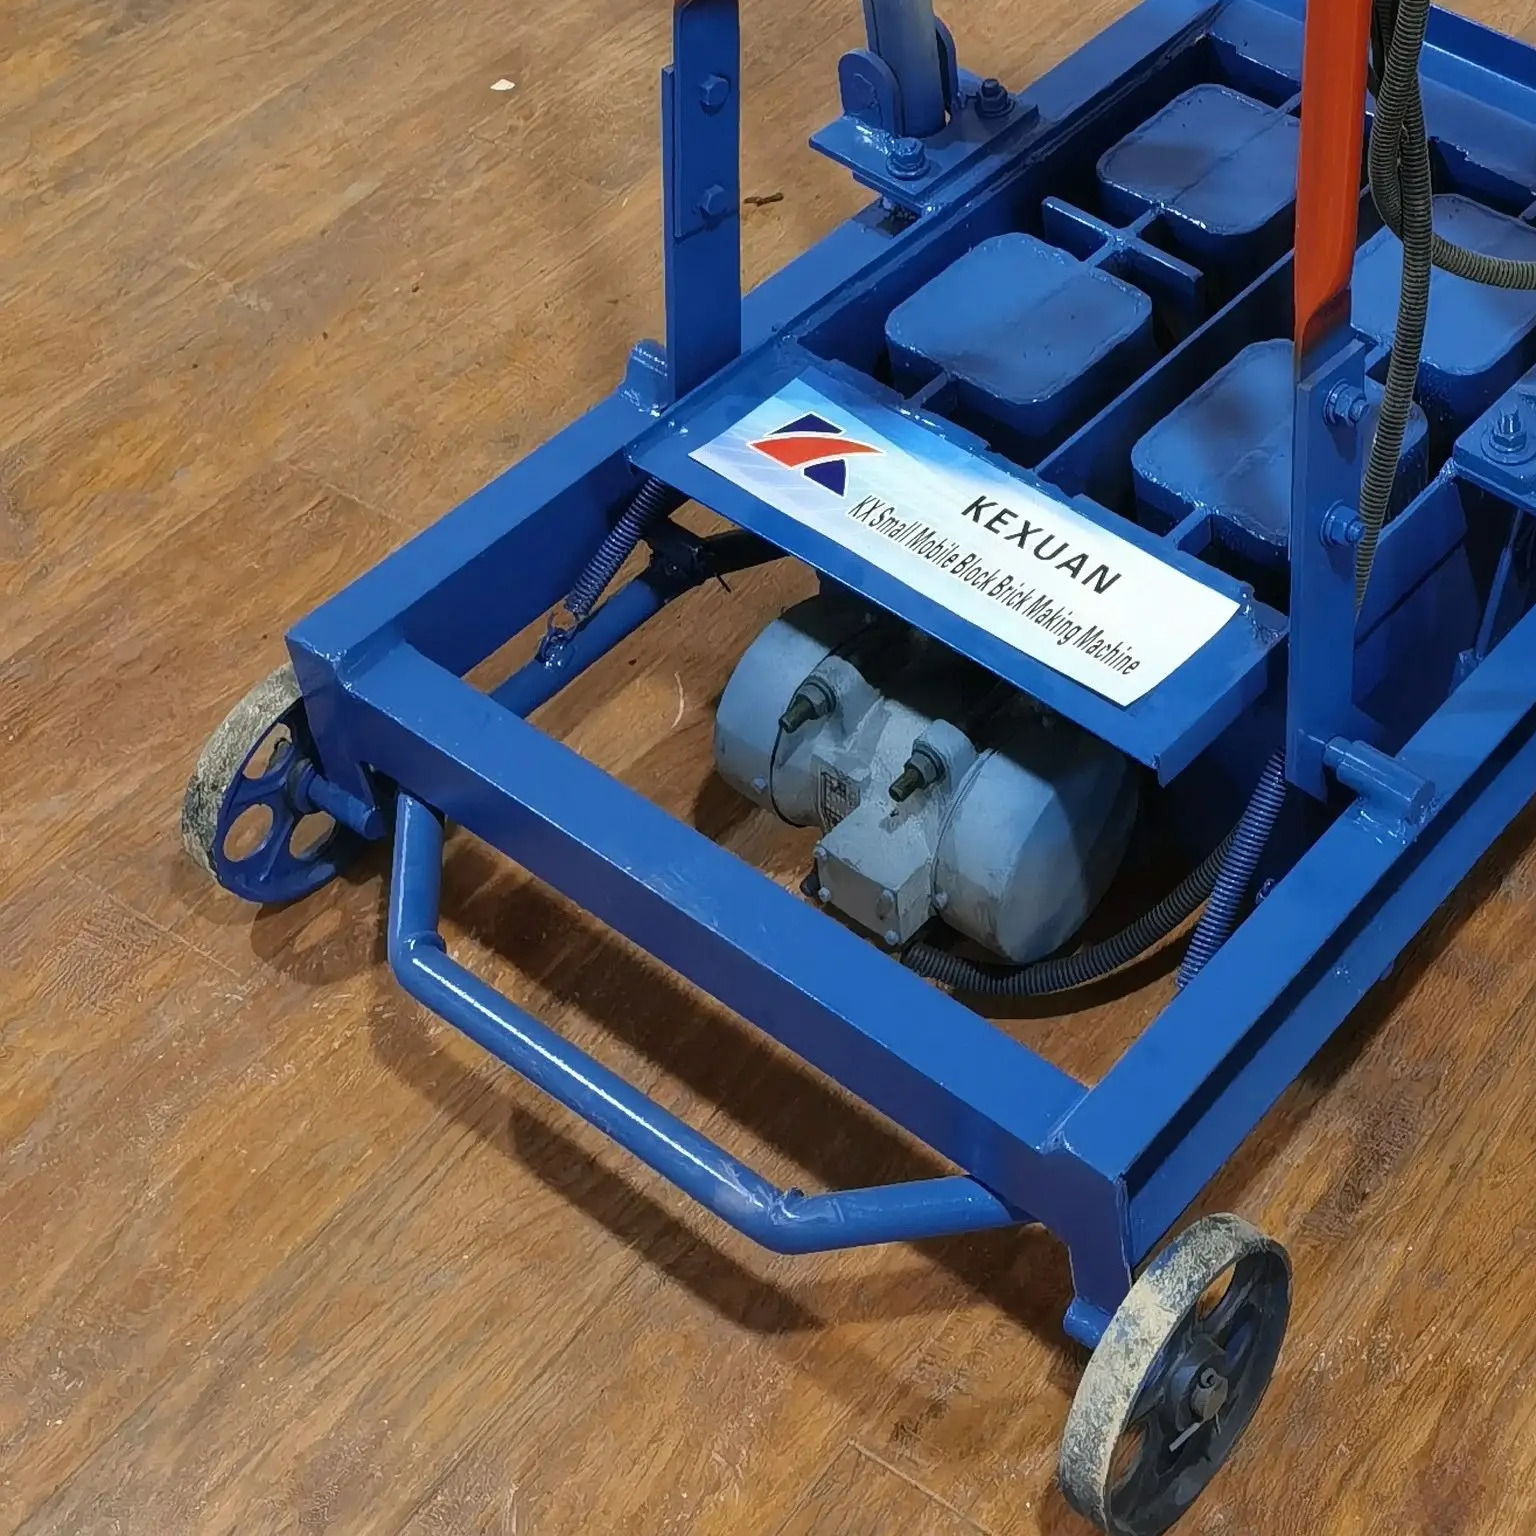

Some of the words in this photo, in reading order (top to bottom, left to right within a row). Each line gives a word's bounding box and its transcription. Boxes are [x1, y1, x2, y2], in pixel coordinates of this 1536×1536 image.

[848, 495, 886, 522] KX
[869, 507, 922, 543] Small
[905, 527, 960, 568] Mobile
[950, 552, 1001, 592] Block
[987, 575, 1036, 612] Brick
[1021, 594, 1083, 646] Making
[1072, 625, 1141, 675] Machine
[961, 495, 1122, 595] KEXUAN
